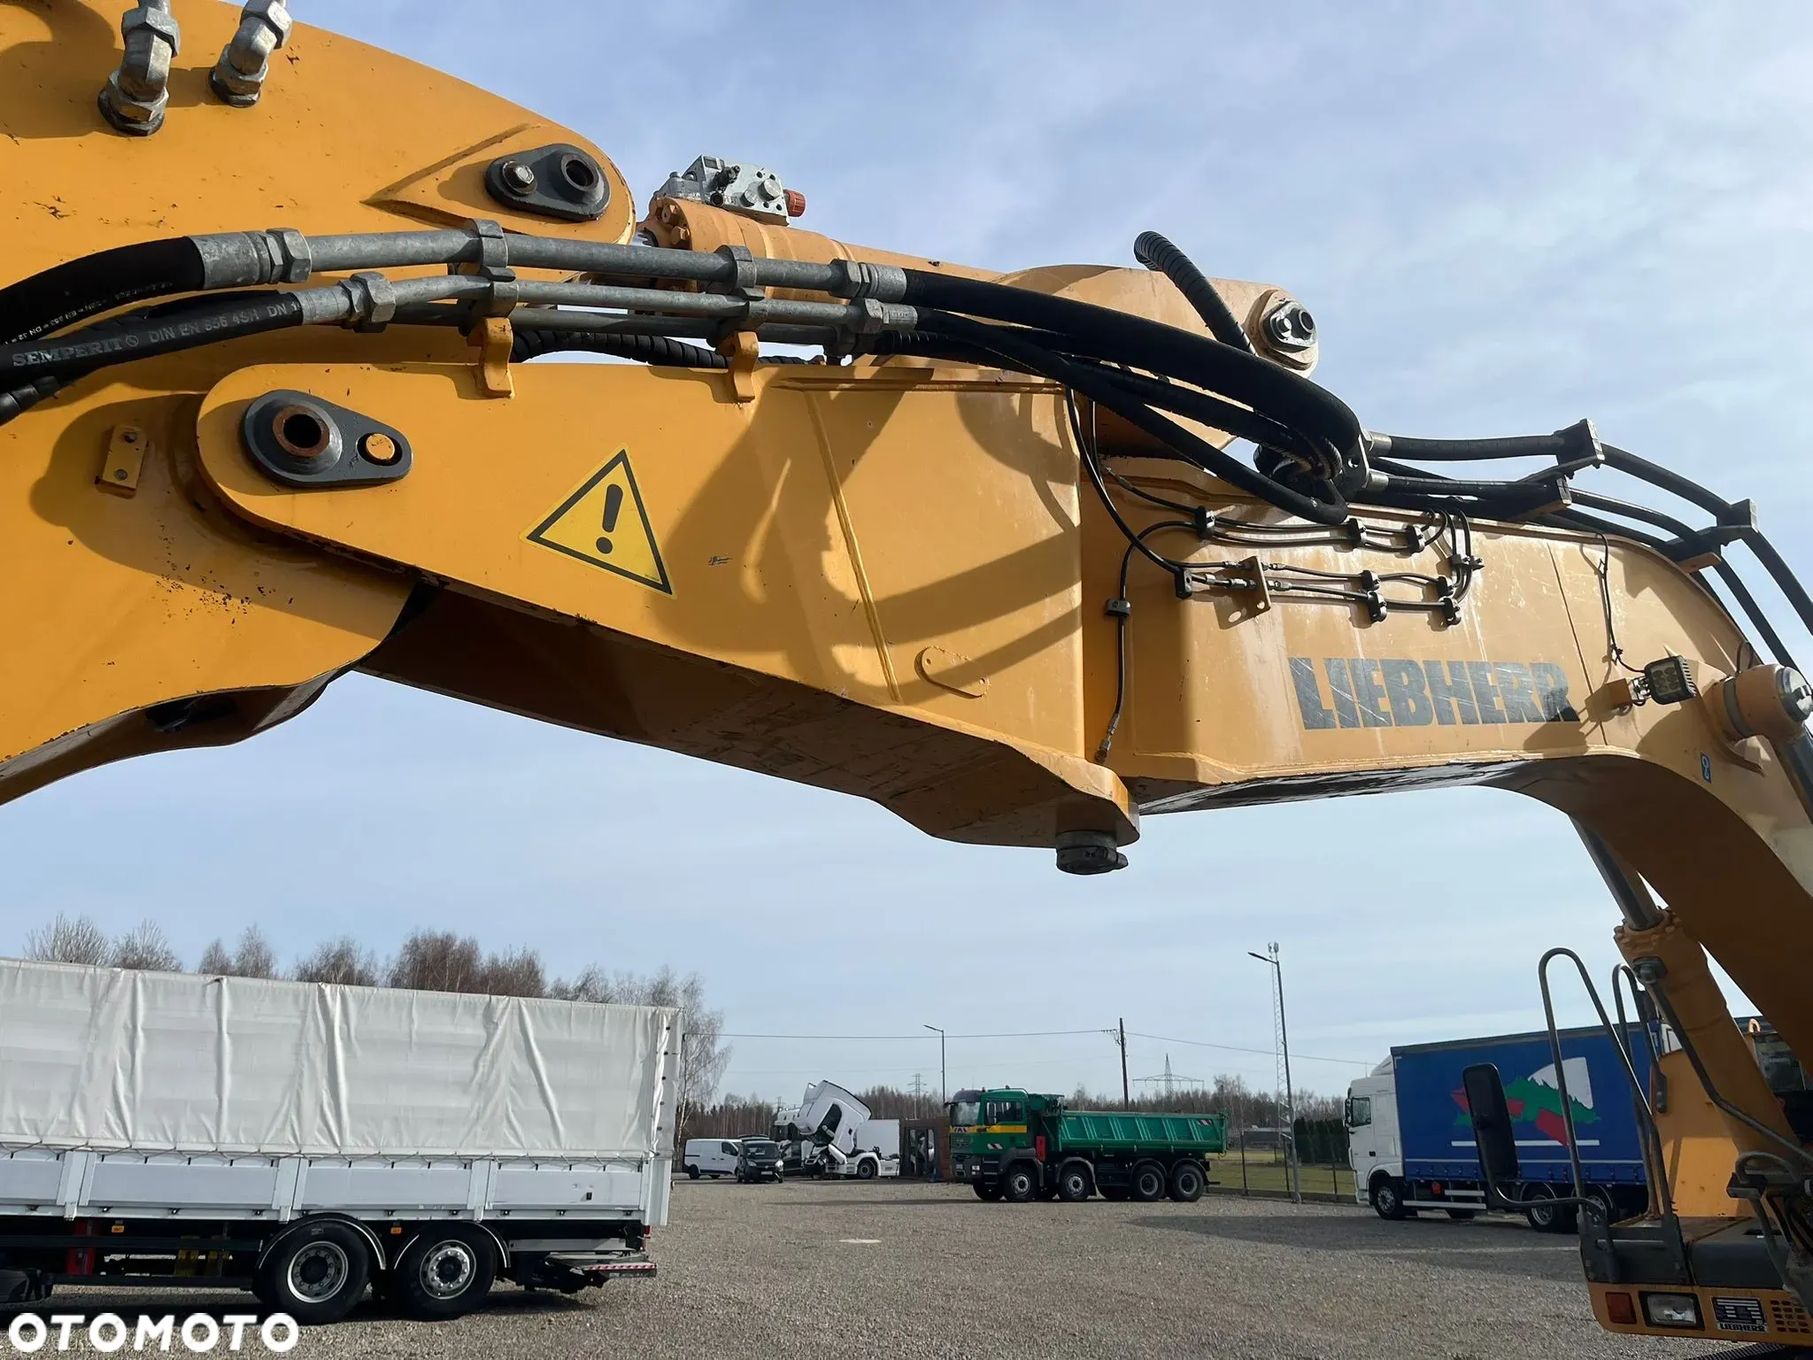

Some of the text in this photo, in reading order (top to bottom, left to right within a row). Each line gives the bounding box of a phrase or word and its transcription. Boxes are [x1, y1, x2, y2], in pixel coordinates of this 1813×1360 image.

[12, 338, 123, 367] SEMPERIT
[149, 325, 176, 343] DIN
[179, 321, 199, 337] EN
[267, 303, 288, 318] DN
[1289, 656, 1580, 731] LIEBHERR
